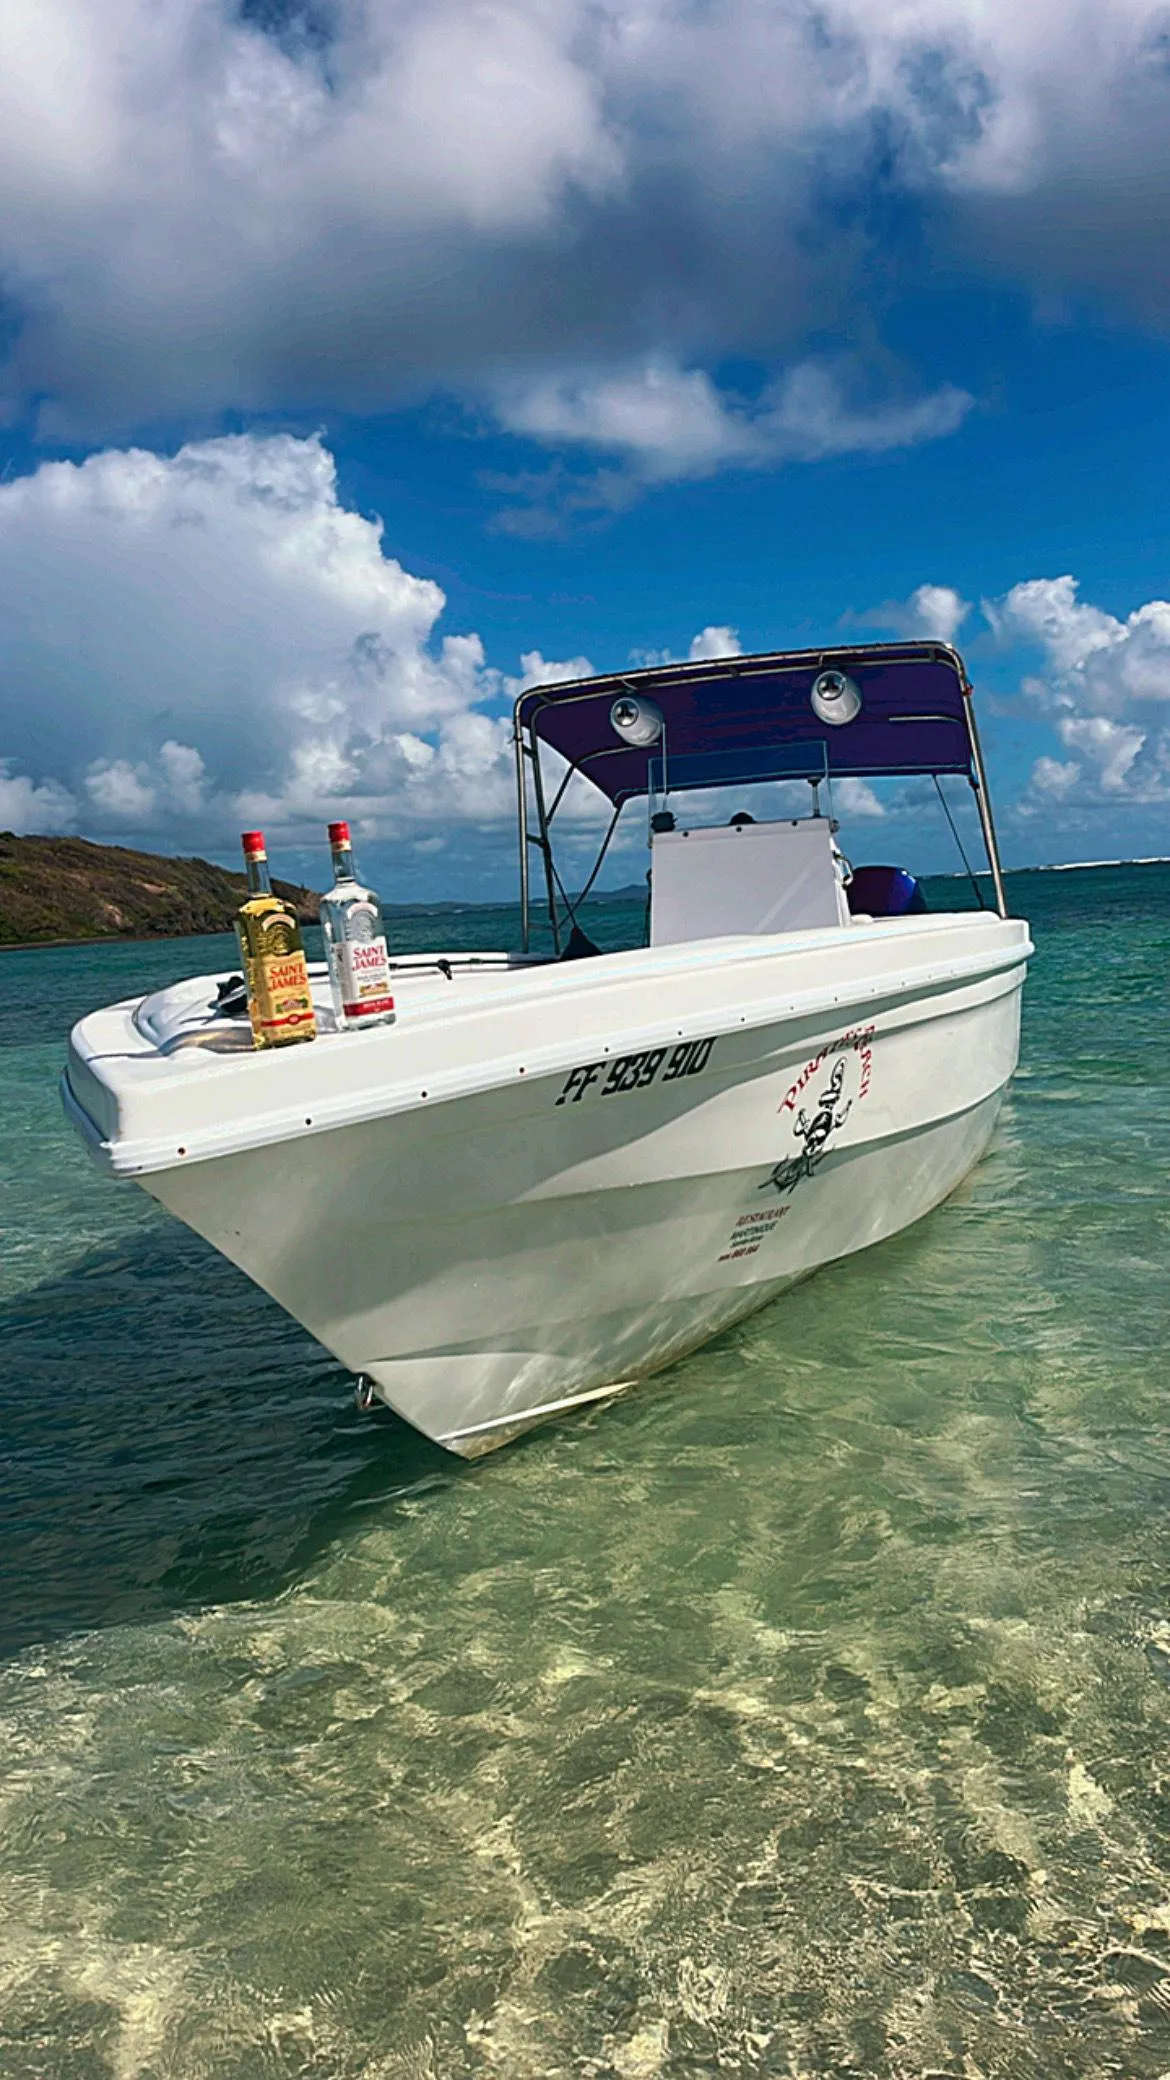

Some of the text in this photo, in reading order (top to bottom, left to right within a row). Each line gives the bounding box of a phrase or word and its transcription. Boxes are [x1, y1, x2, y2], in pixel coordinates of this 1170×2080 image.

[353, 945, 384, 959] SAINT
[269, 963, 304, 979] SAINT
[352, 956, 387, 971] JAMES
[268, 974, 307, 992] JAMES
[555, 1037, 718, 1106] FF 939 910
